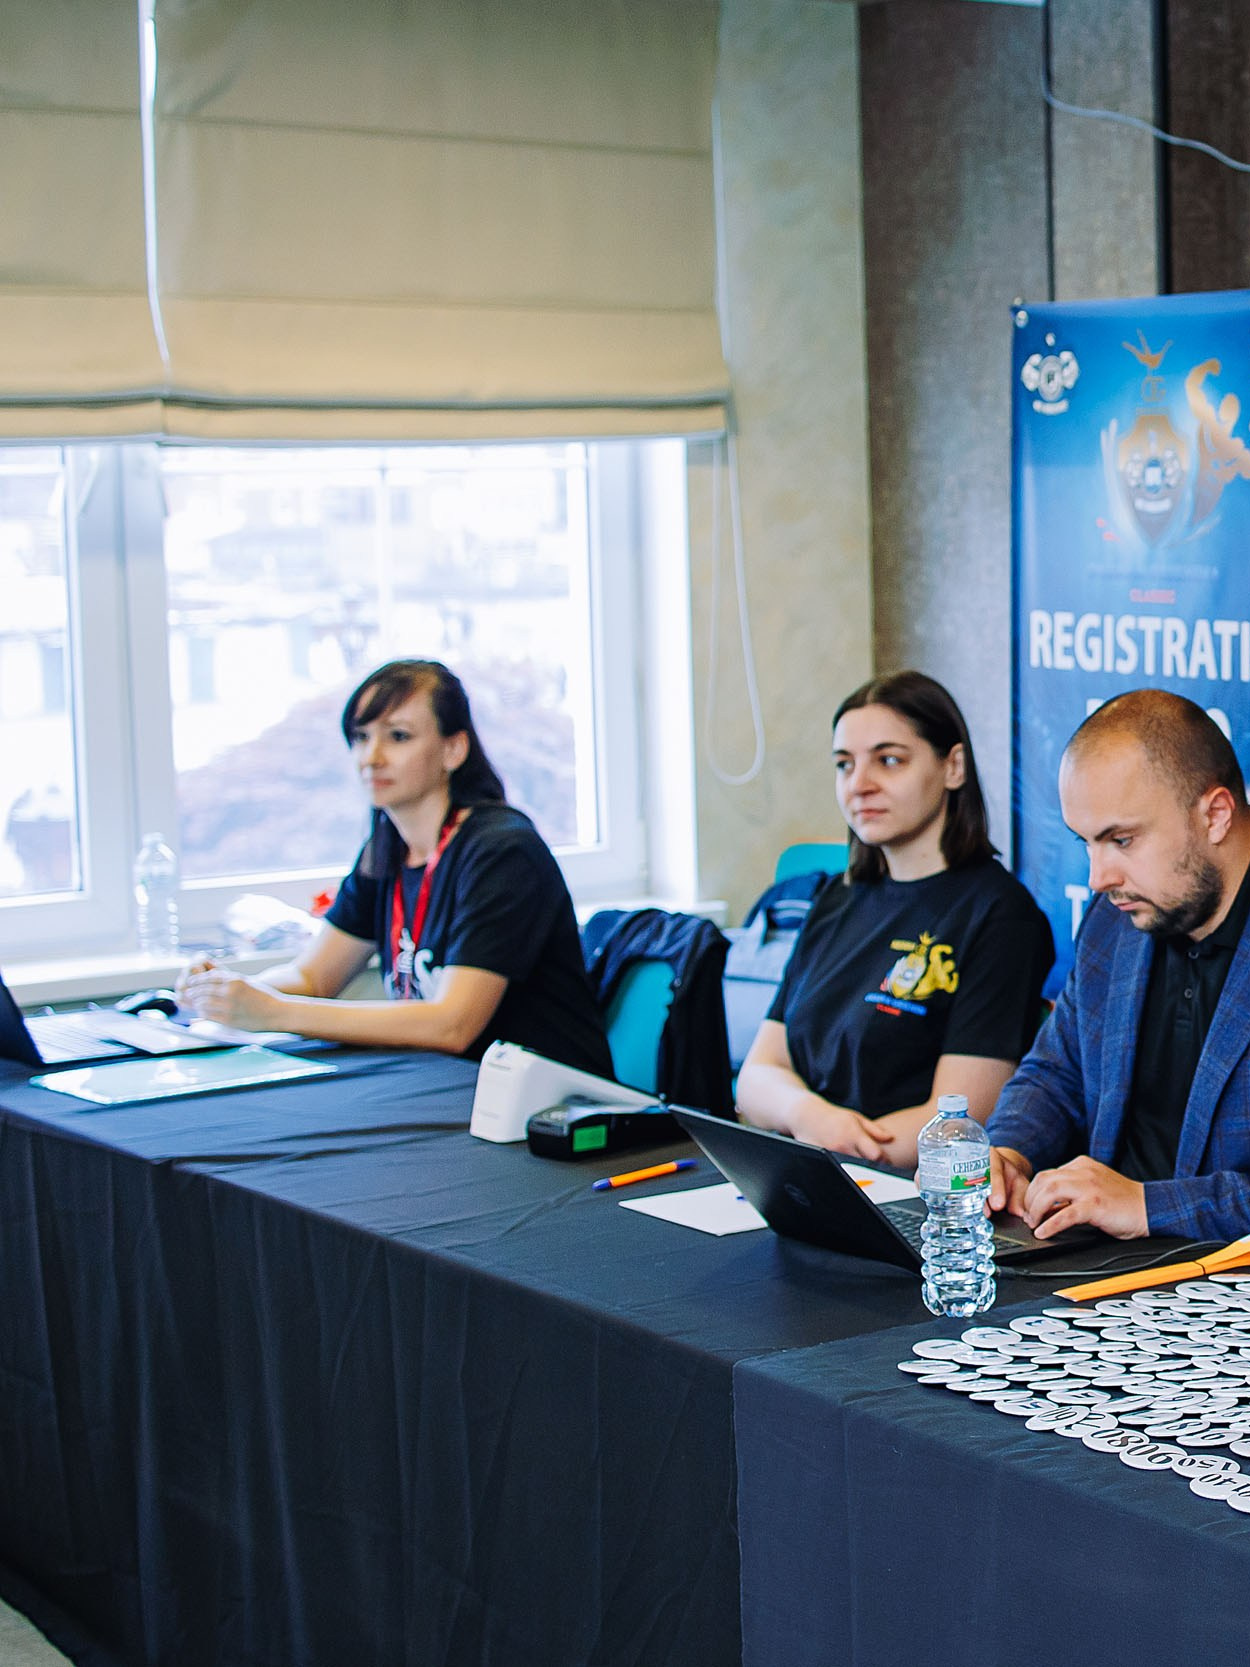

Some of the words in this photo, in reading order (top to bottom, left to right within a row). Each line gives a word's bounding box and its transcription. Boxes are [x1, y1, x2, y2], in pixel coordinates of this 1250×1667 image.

[1091, 1430, 1144, 1447] 80
[1127, 1444, 1182, 1464] 90
[1178, 1458, 1232, 1471] 150
